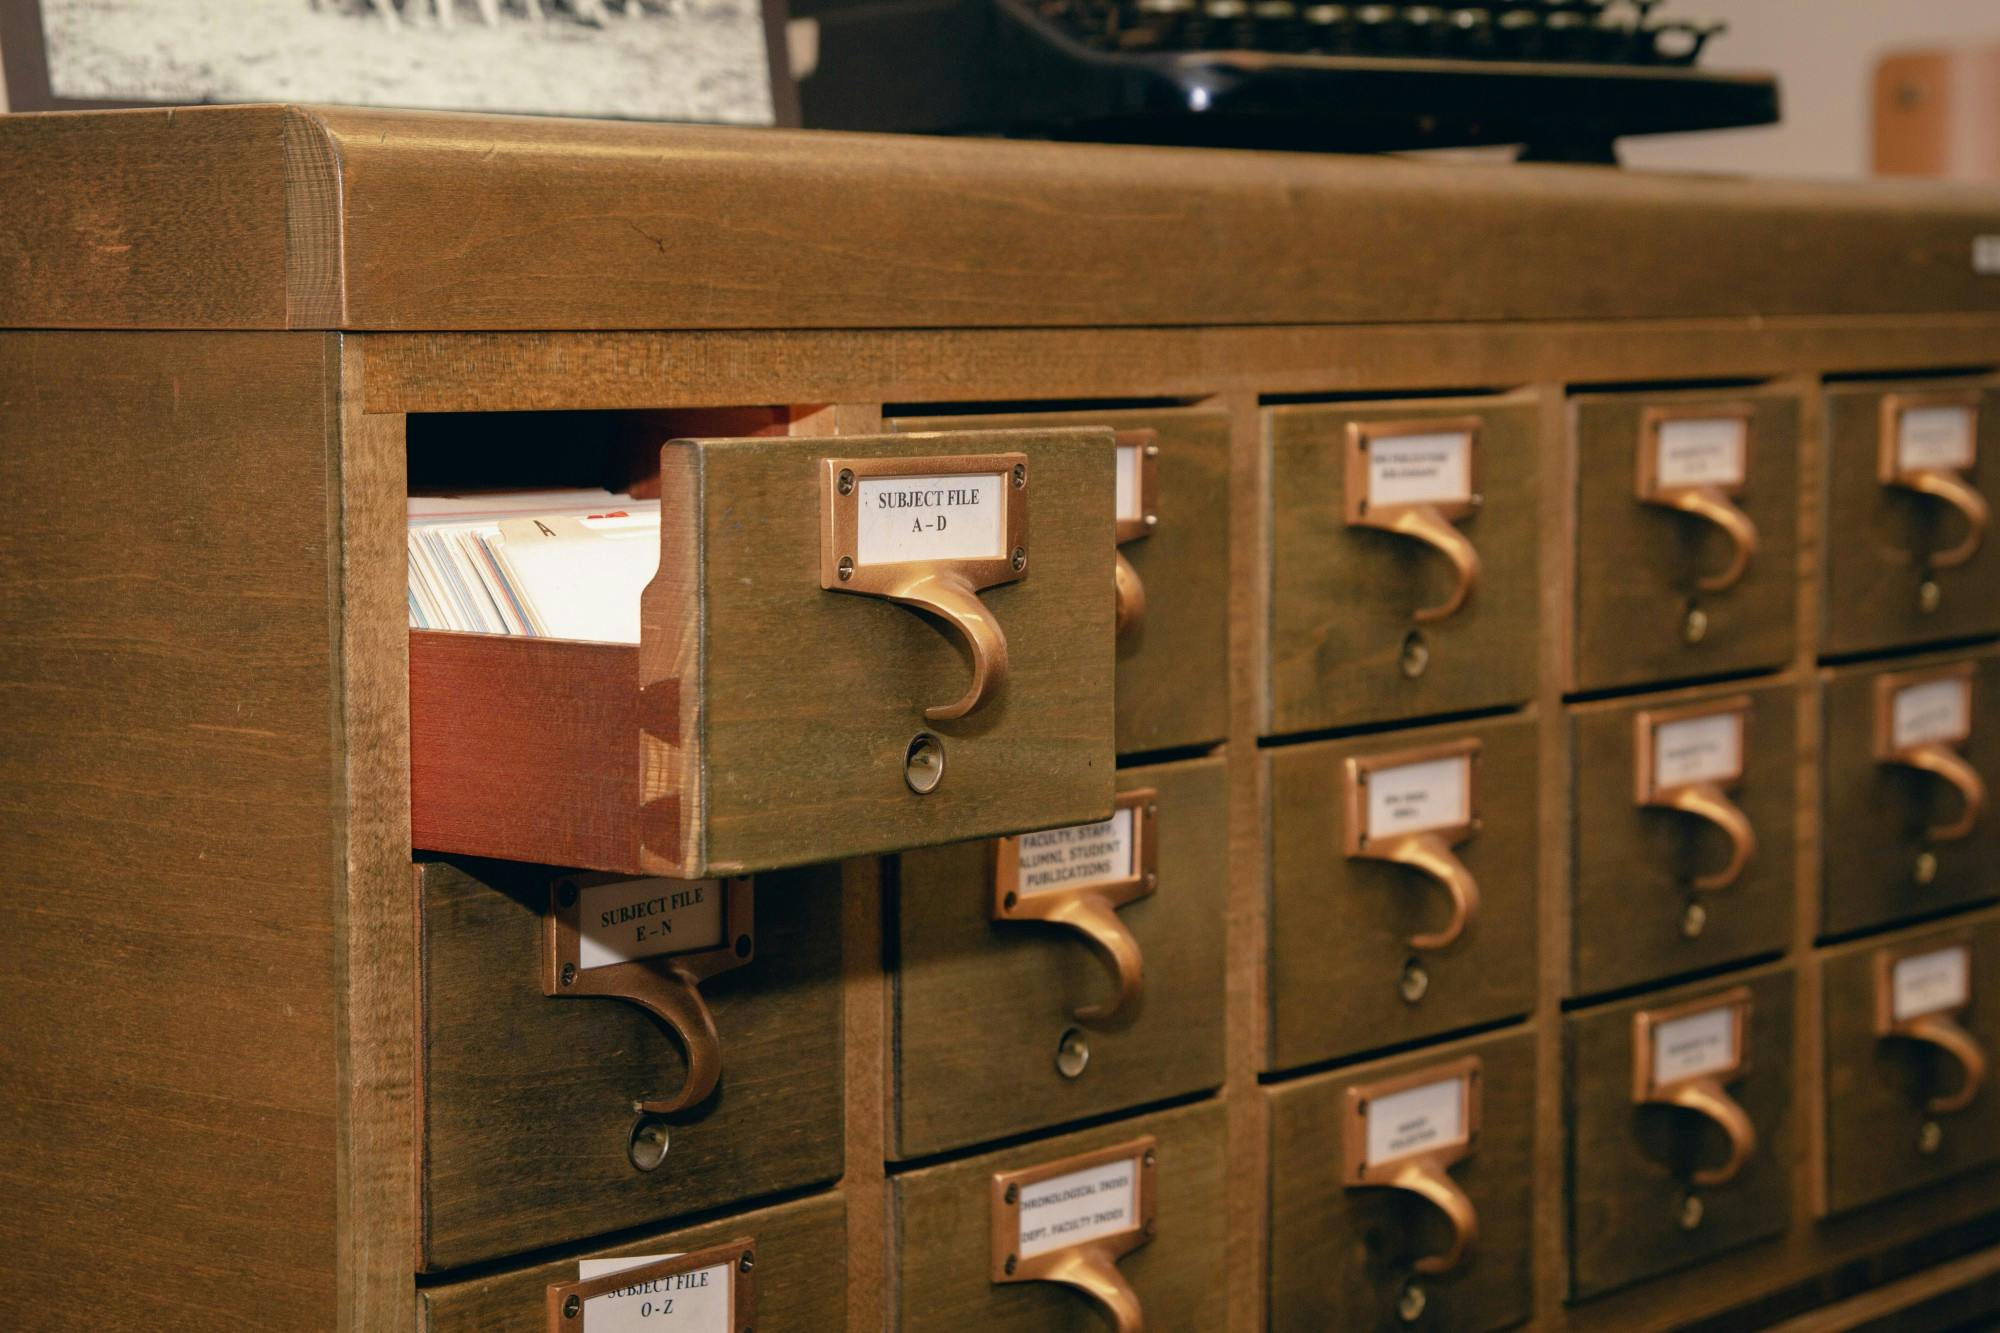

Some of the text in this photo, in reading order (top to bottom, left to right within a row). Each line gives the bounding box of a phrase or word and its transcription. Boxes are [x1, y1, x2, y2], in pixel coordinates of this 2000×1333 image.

[878, 488, 980, 508] SUBJECT FILE
[532, 519, 557, 537] A
[1069, 840, 1121, 860] STUDENT
[1027, 861, 1110, 886] PUBLICATIONS
[601, 888, 703, 927] SUBJECT FILE
[1051, 1216, 1092, 1235] FACULTY
[676, 1272, 708, 1290] FILE
